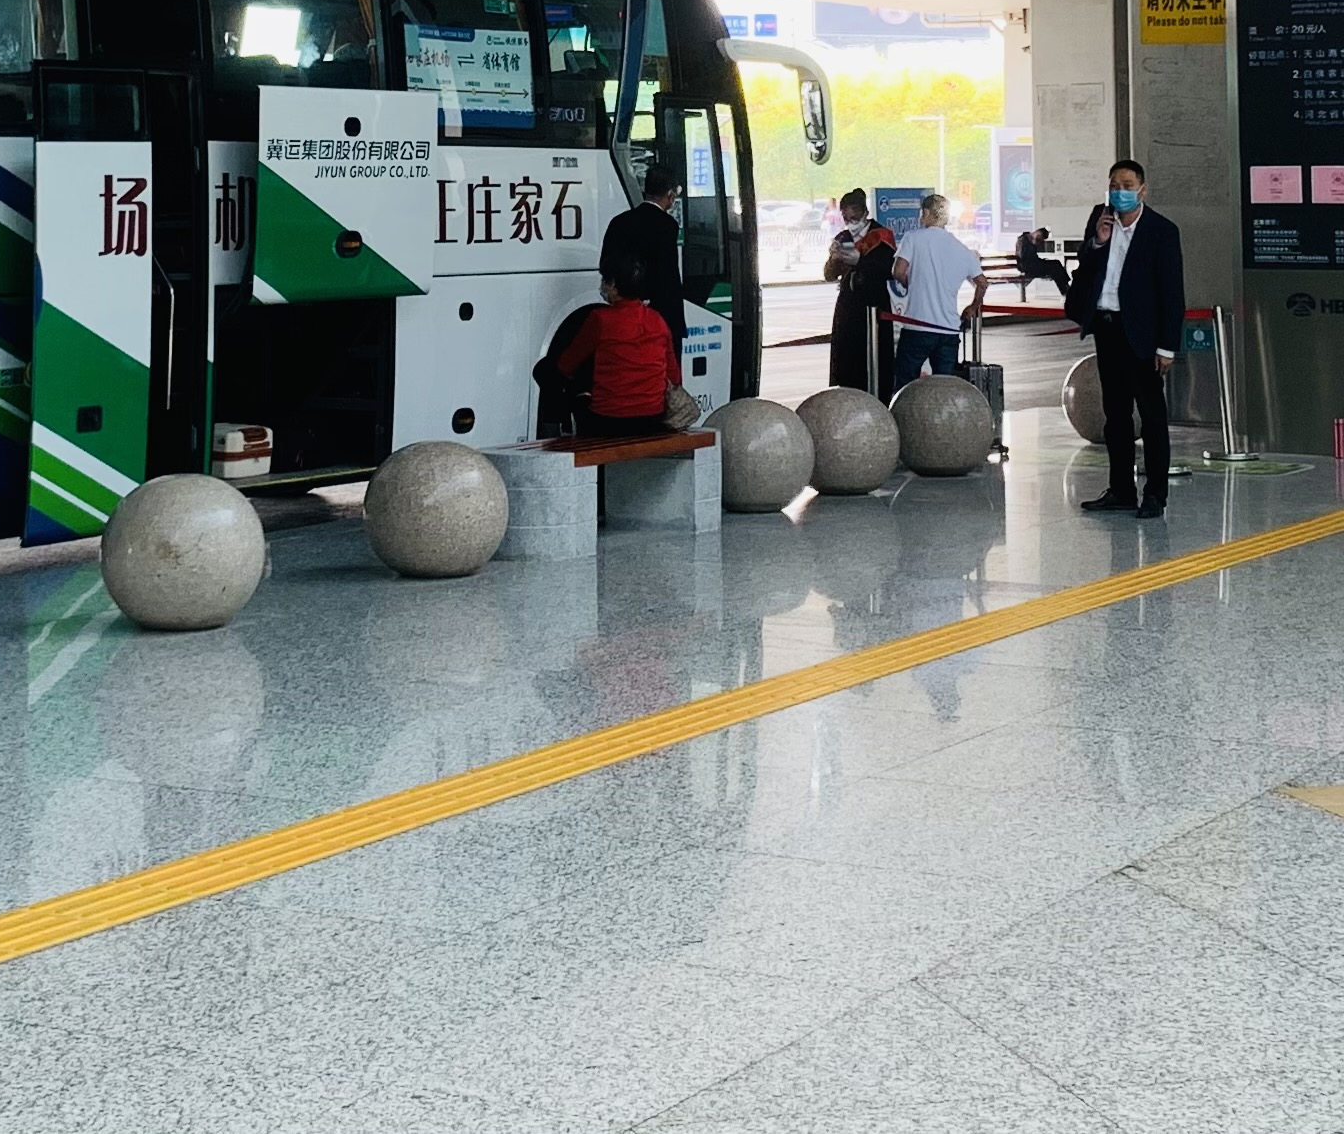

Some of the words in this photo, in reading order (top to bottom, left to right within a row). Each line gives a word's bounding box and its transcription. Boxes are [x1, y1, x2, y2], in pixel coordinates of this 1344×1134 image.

[1147, 15, 1176, 26] Please
[1178, 15, 1190, 26] do
[1192, 15, 1207, 25] not
[1209, 14, 1226, 25] tak
[1292, 25, 1304, 34] 20
[266, 139, 431, 161] 冀运集团股份有限公司
[315, 165, 346, 178] JIYUN
[350, 165, 386, 178] GROUP
[98, 174, 148, 257] 场
